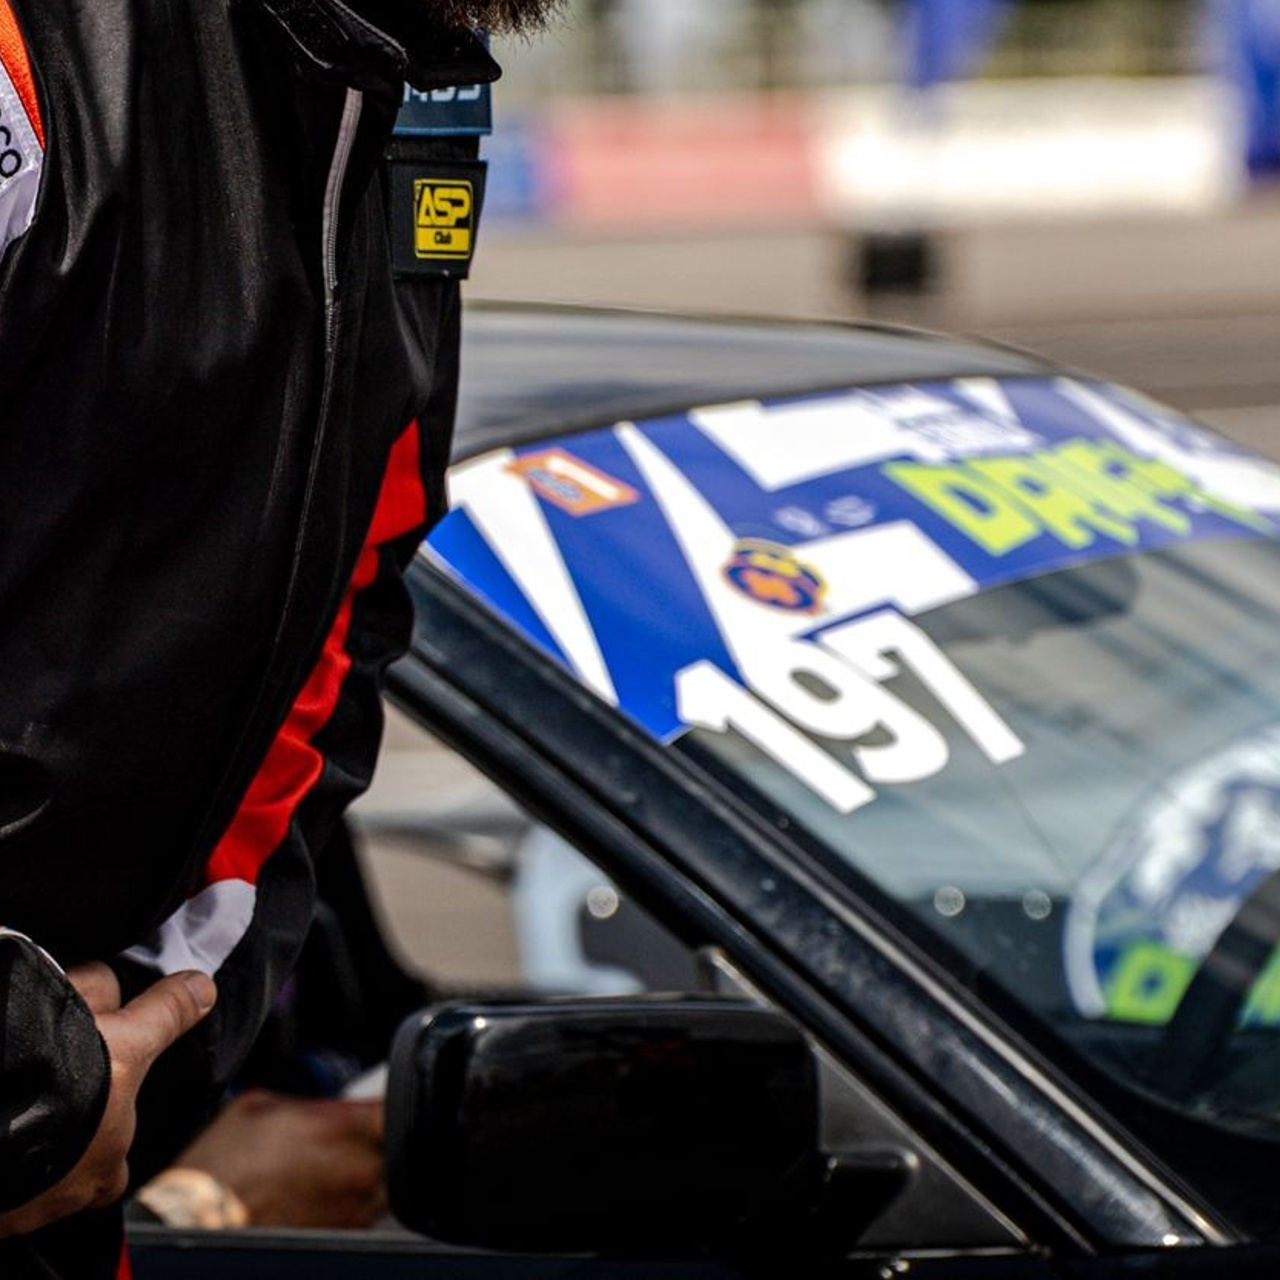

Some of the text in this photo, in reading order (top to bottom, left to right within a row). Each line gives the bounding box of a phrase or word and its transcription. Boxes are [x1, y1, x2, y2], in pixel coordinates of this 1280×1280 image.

[417, 185, 471, 227] ASP
[433, 230, 453, 245] Club
[673, 604, 1025, 813] 197
